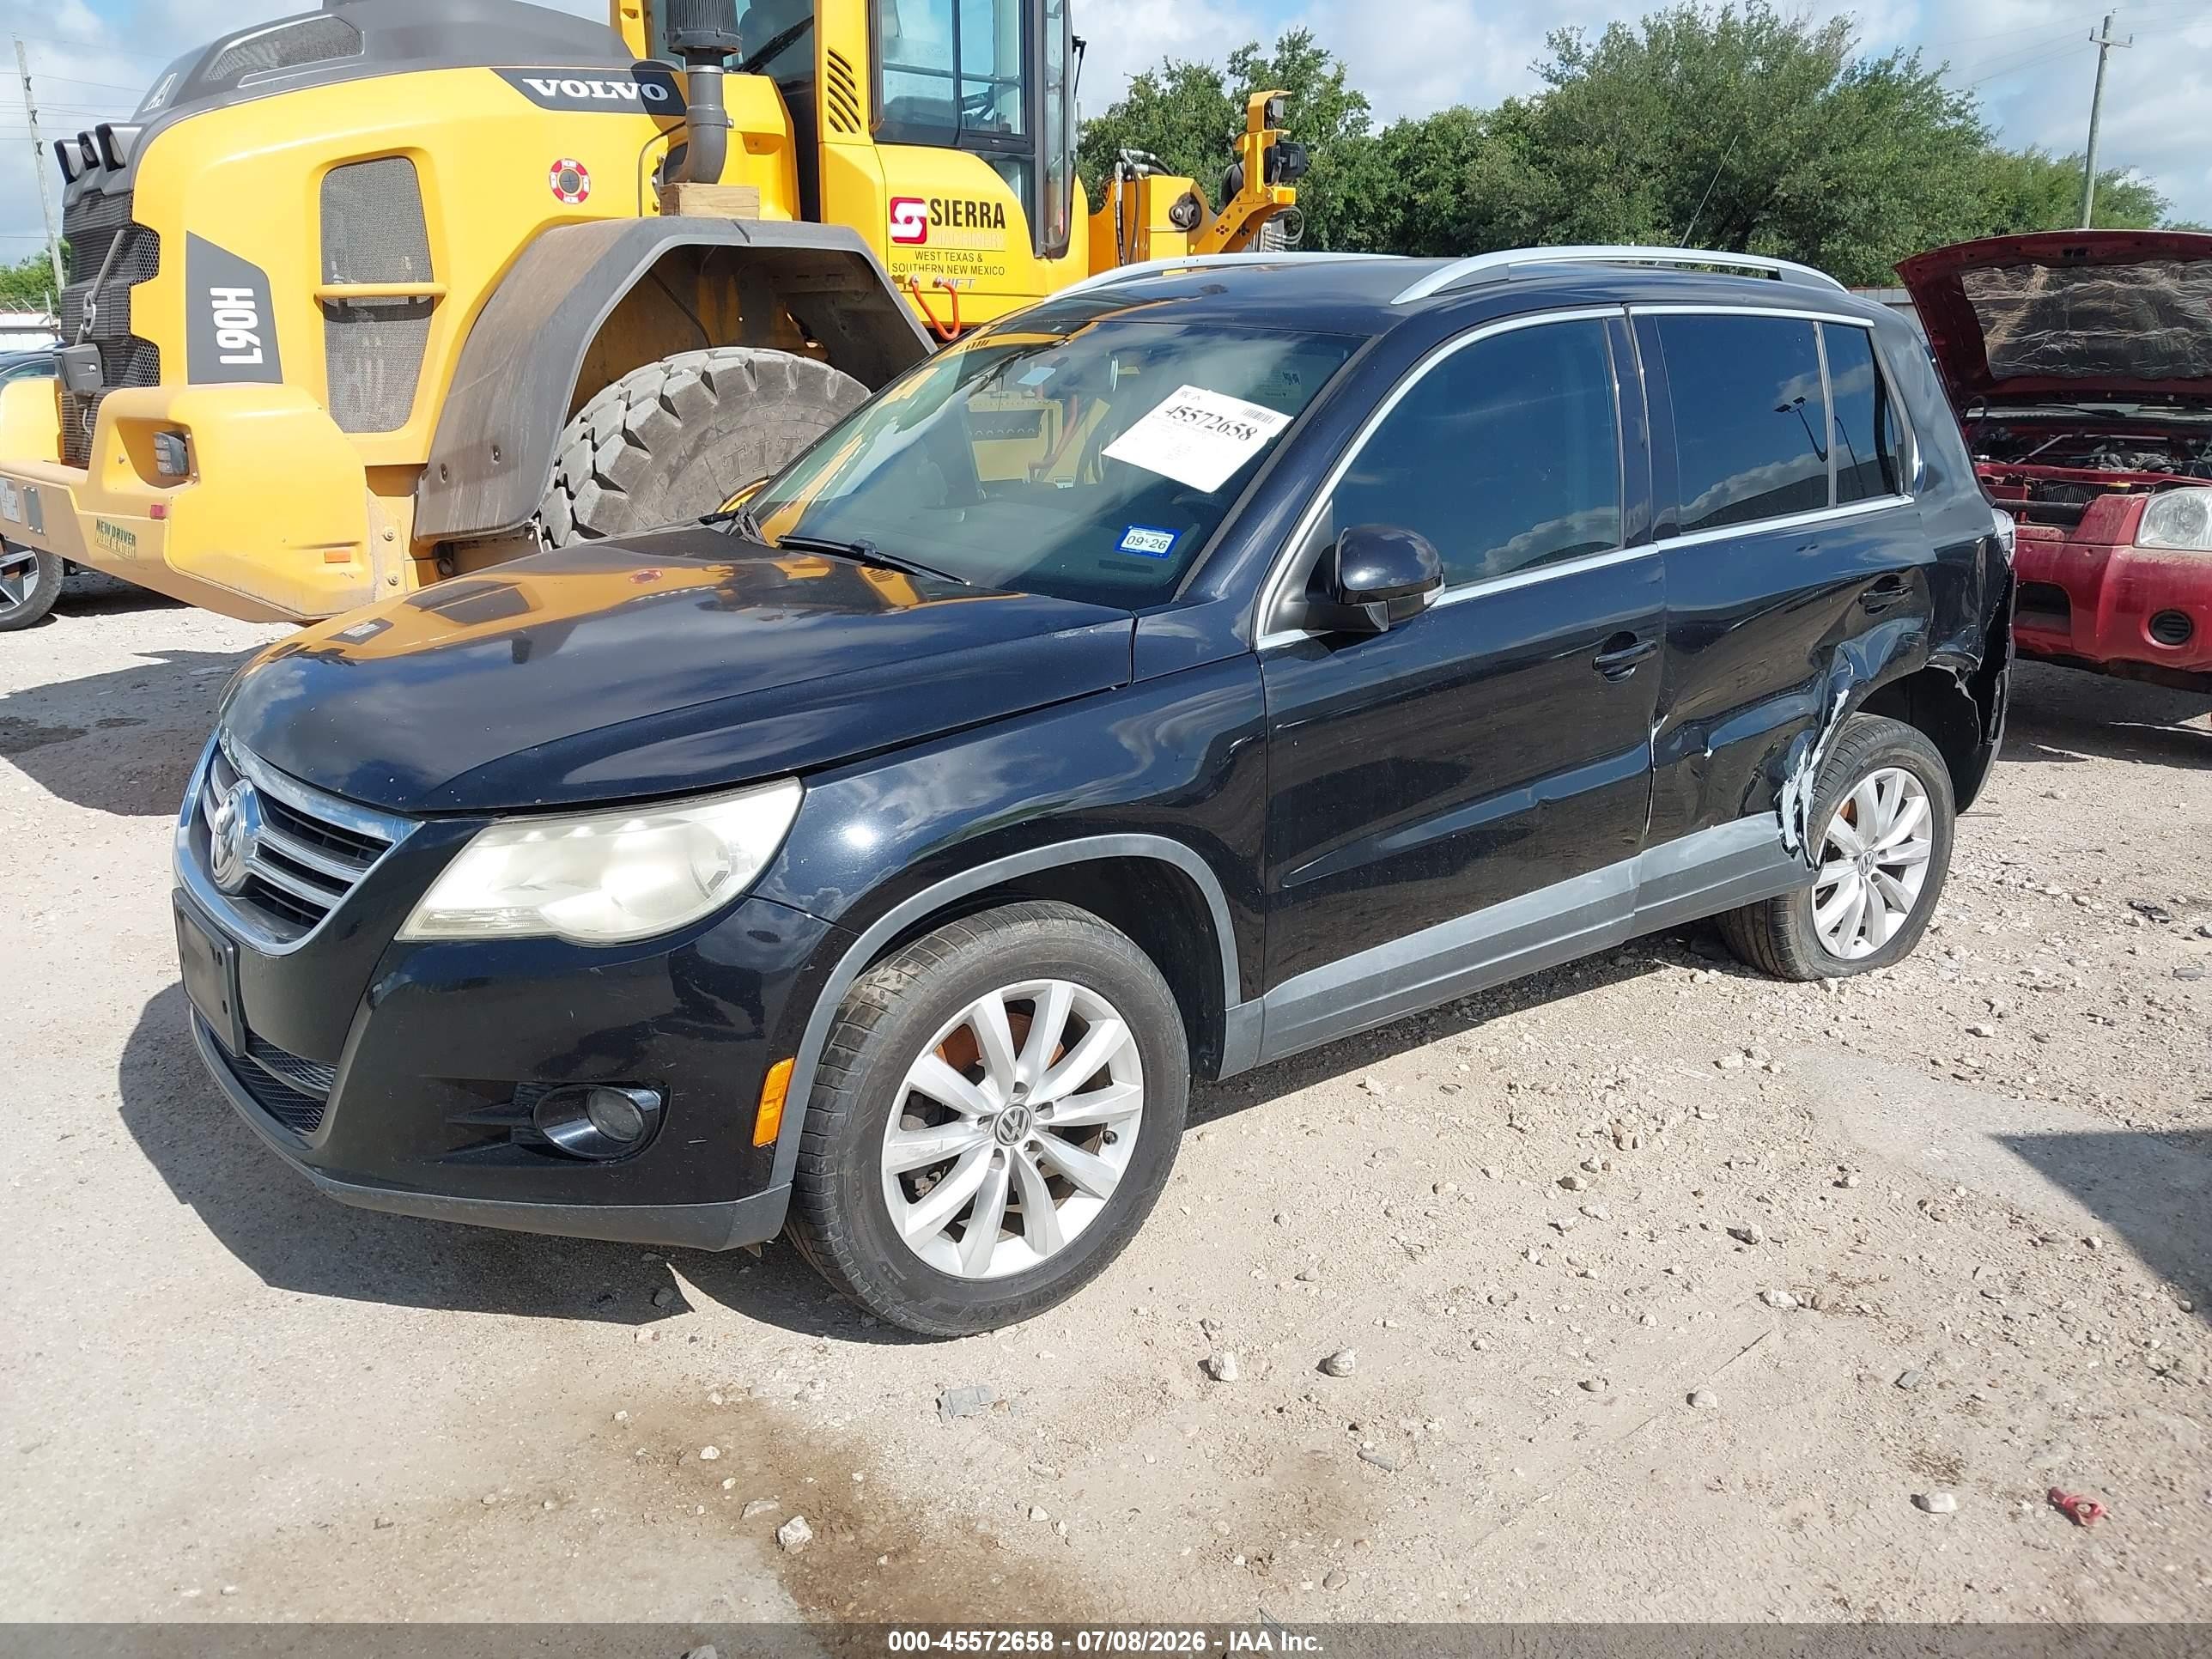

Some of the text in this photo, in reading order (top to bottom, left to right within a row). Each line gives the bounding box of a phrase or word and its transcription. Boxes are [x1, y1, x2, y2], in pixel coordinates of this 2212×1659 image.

[521, 78, 669, 101] VOLVO
[929, 198, 1006, 229] SIERRA
[931, 230, 1005, 248] MACHINERY
[915, 250, 983, 263] WEST TEXAS &
[891, 262, 1006, 276] SOUTHERN NEW MEXICO
[210, 287, 264, 364] L90H
[1164, 404, 1258, 441] 45572658
[96, 518, 136, 546] NEW DRIVER
[1126, 535, 1168, 550] 09 26
